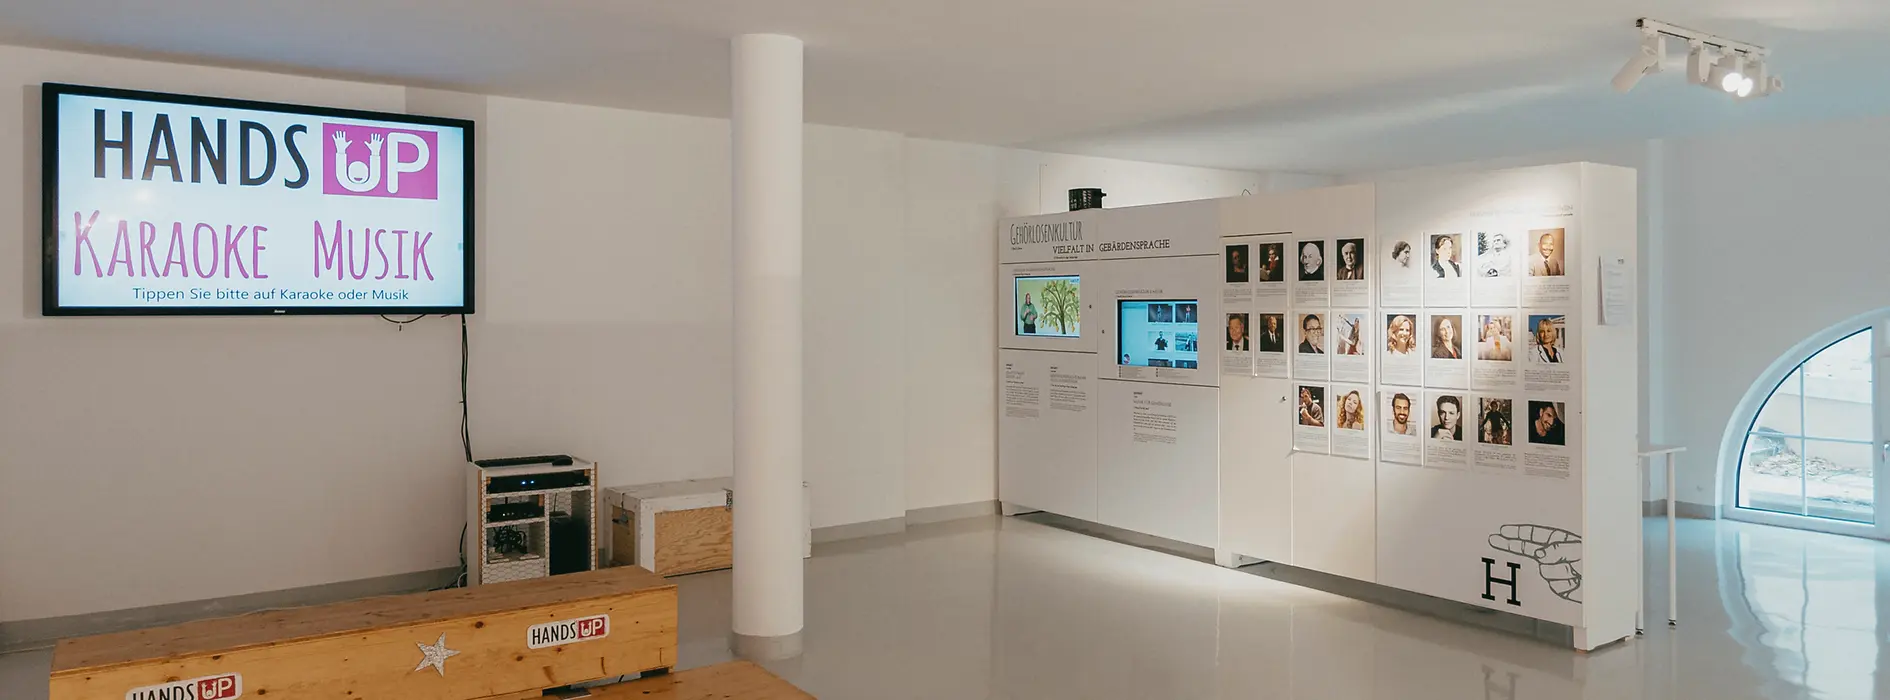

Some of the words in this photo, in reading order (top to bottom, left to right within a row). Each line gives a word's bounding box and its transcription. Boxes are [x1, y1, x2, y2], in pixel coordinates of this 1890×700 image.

[94, 108, 310, 189] HANDS
[332, 130, 430, 194] UP
[74, 210, 269, 279] KARAOKE
[314, 219, 434, 281] MUSIK
[1009, 221, 1083, 246] GEHÖRLOSENKULTUR
[1053, 244, 1085, 254] VIELFALT
[1085, 243, 1095, 253] IN
[1098, 239, 1171, 252] GEBÄRDENSPRACHE
[132, 288, 184, 302] Tippen
[190, 288, 211, 300] Sie
[216, 288, 249, 300] bitte
[253, 288, 276, 300] auf
[280, 289, 334, 300] Karaoke
[337, 289, 368, 300] oder
[372, 289, 409, 300] Musik
[1481, 556, 1521, 607] H
[532, 622, 576, 645] HANDS
[580, 619, 603, 637] UP
[201, 677, 233, 700] UP
